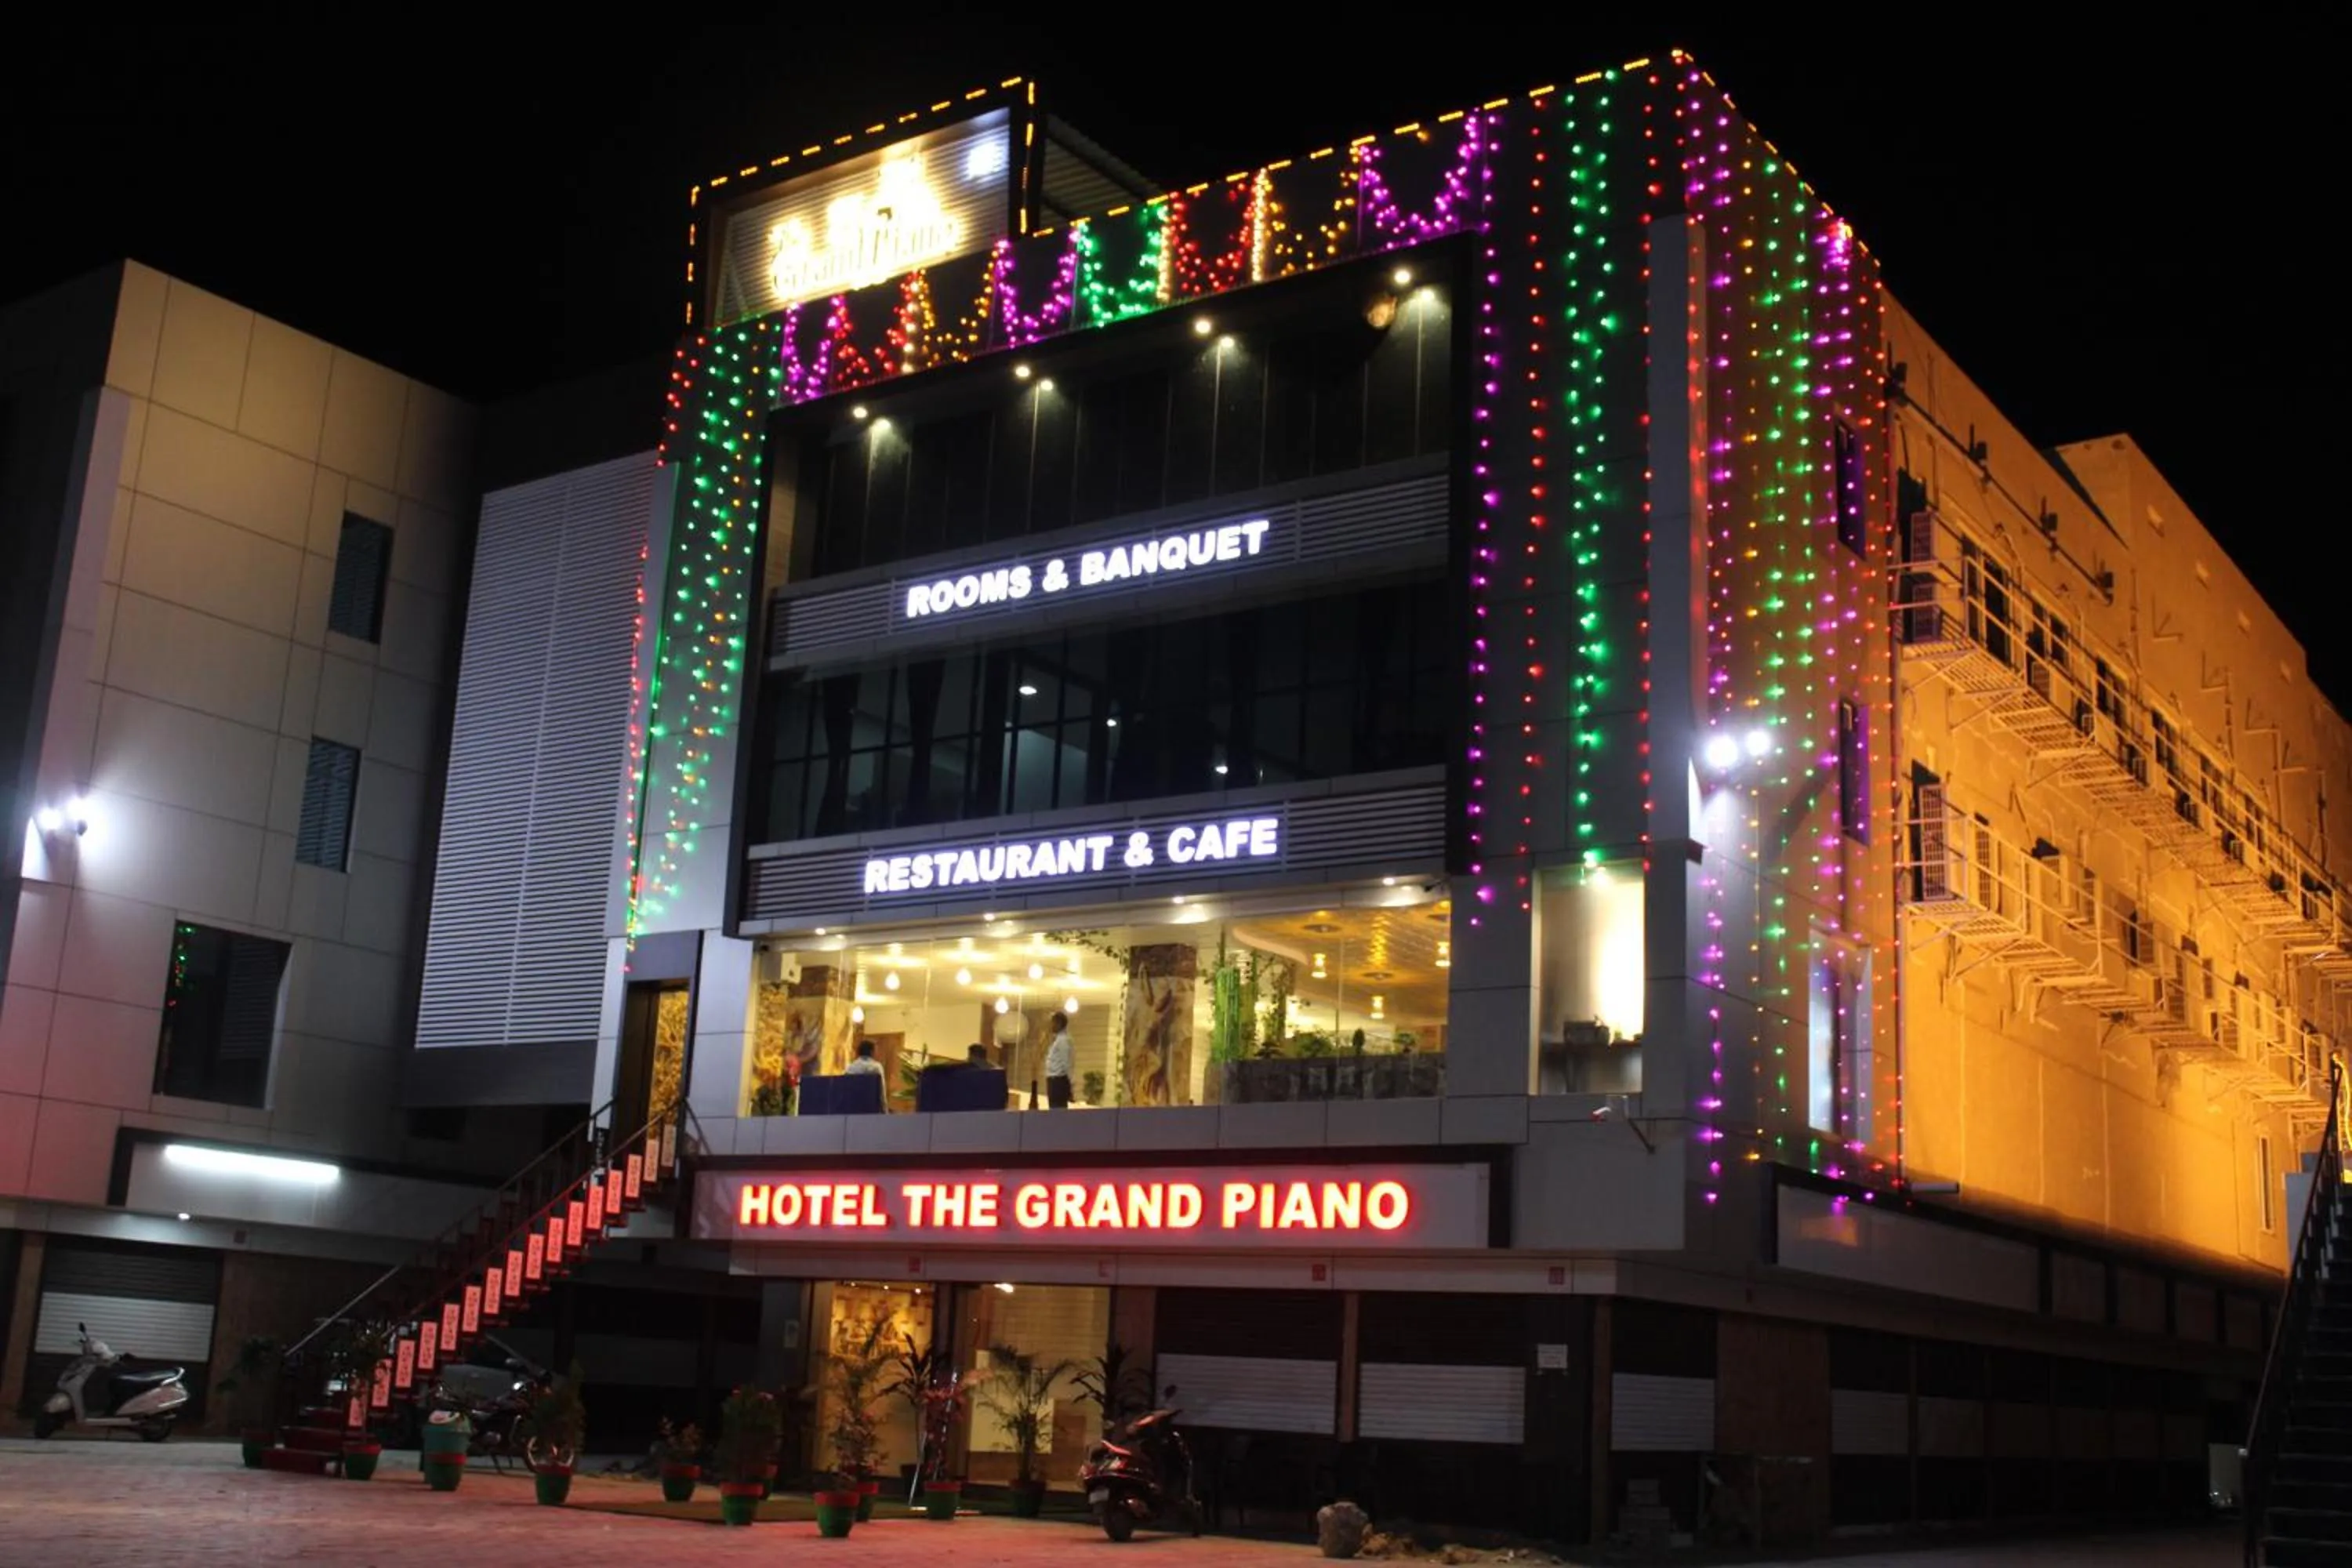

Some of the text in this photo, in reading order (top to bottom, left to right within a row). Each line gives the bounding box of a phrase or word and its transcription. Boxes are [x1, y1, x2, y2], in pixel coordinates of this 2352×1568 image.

[907, 520, 1269, 618] ROOMS & BANQUET
[864, 818, 1278, 893] RESTAURANT & CAFE
[739, 1180, 1410, 1230] HOTEL THE GRAND PIANO
